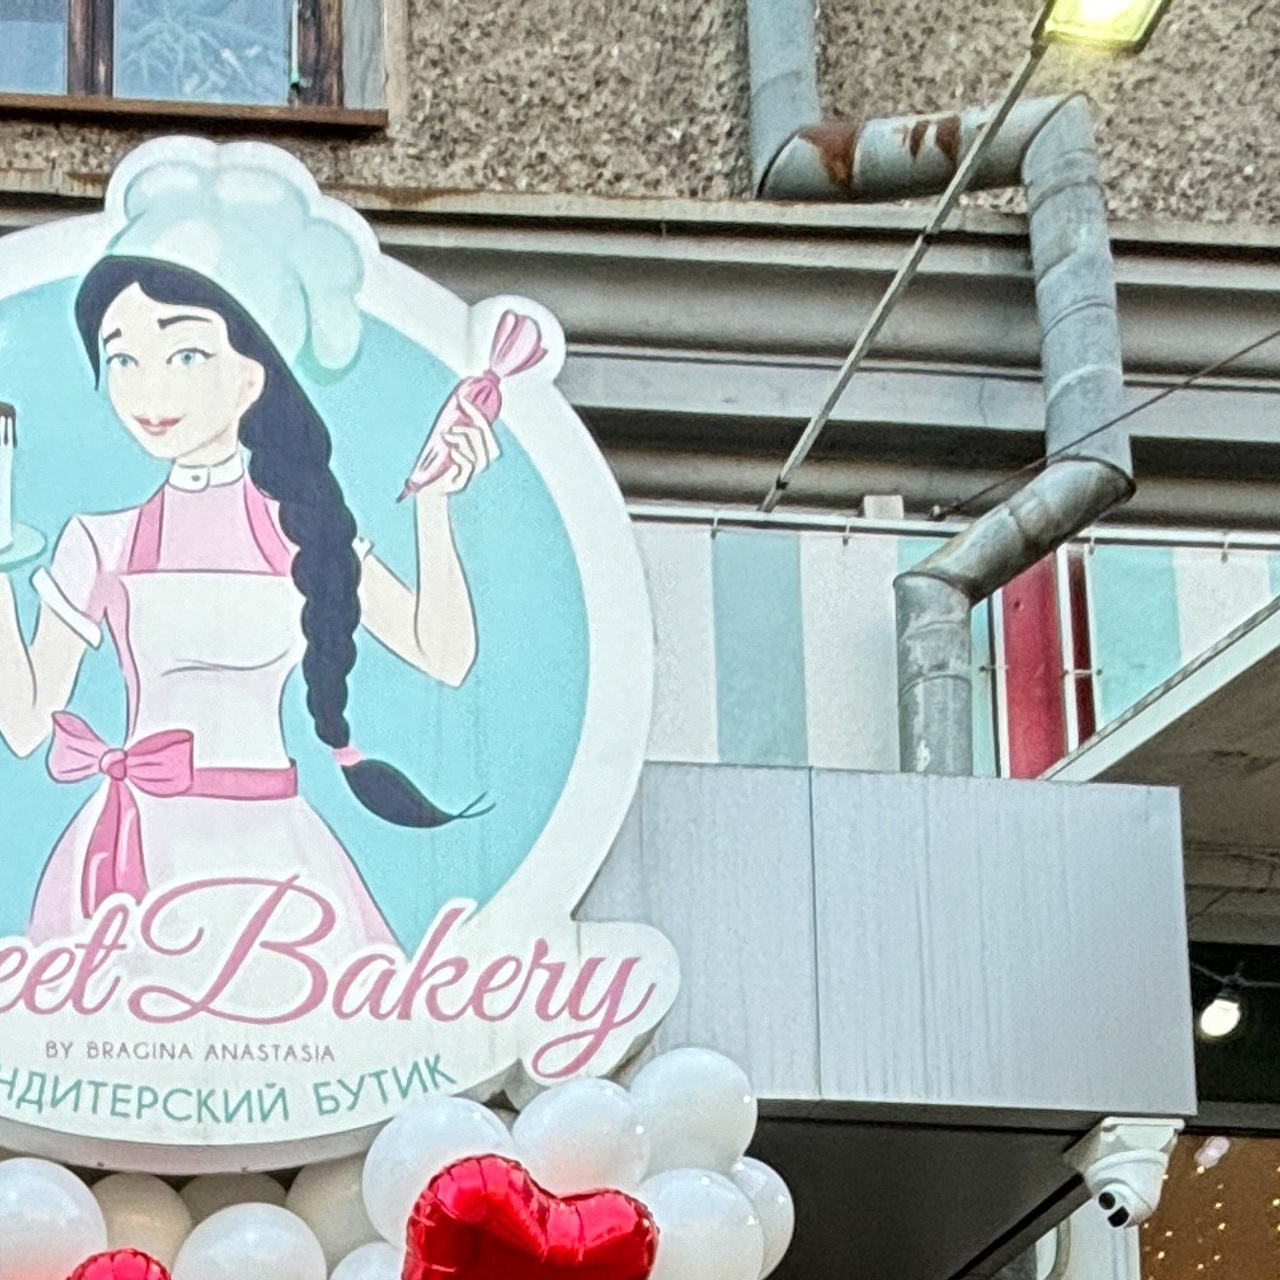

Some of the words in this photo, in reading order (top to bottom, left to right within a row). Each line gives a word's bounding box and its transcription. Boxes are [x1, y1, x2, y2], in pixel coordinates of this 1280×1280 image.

[127, 874, 658, 1080] Bakery
[44, 1039, 74, 1060] BY
[85, 1041, 194, 1061] BRAGINA
[203, 1042, 337, 1064] ANASTASIA
[312, 1054, 458, 1116] БУТИК
